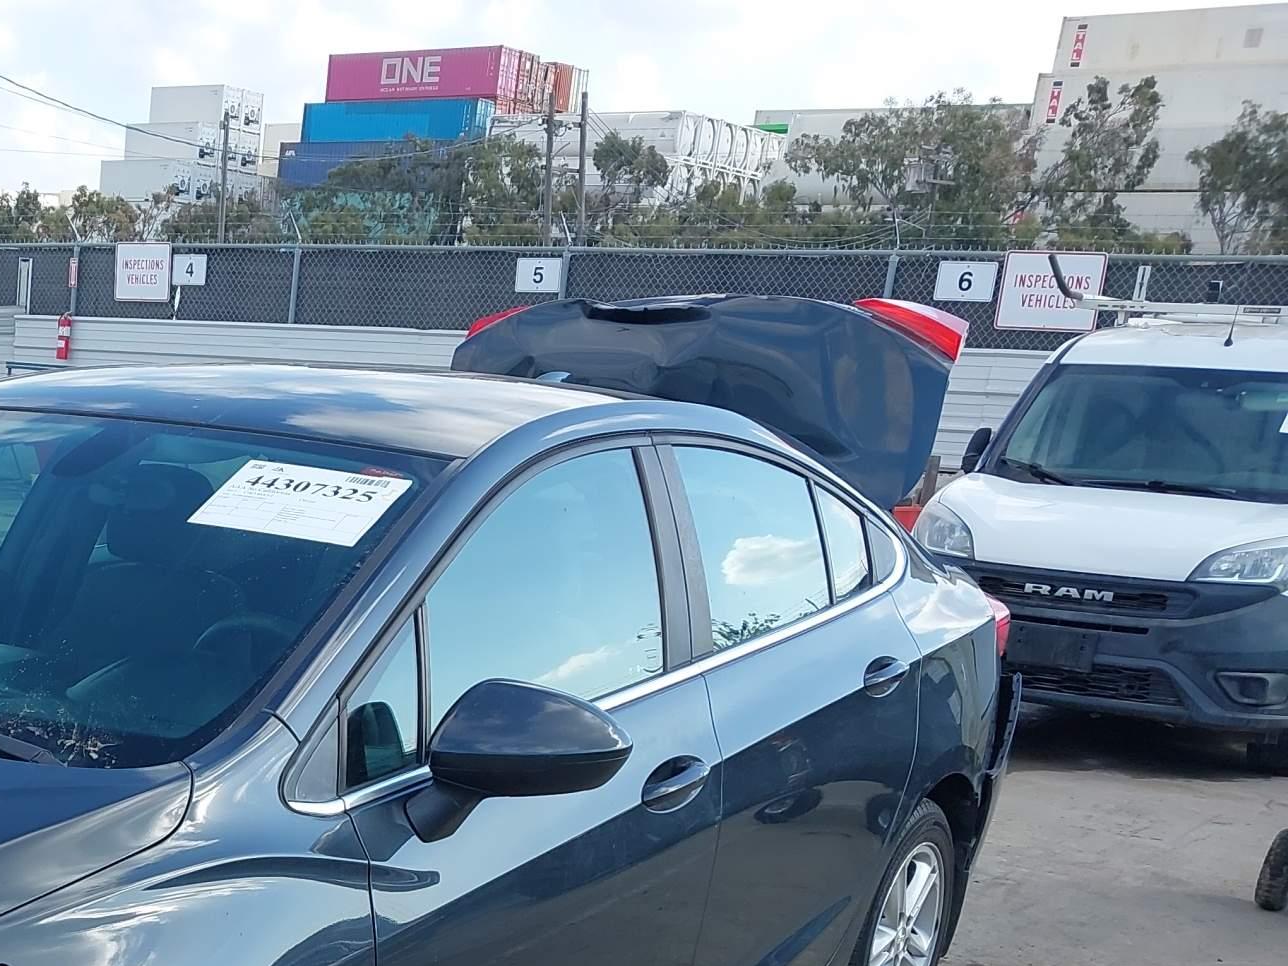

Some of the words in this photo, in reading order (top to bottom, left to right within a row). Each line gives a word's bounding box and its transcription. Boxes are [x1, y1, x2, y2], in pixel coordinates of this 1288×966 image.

[1072, 31, 1086, 60] TAL
[381, 56, 441, 84] ONE
[122, 259, 164, 270] INSPECTIONS
[185, 262, 194, 278] 4
[127, 273, 158, 285] VEHICLES
[532, 266, 544, 284] 5
[958, 271, 974, 292] 6
[1014, 274, 1091, 290] INSPECONS
[245, 475, 378, 502] 44307325
[1023, 582, 1114, 602] RAM
